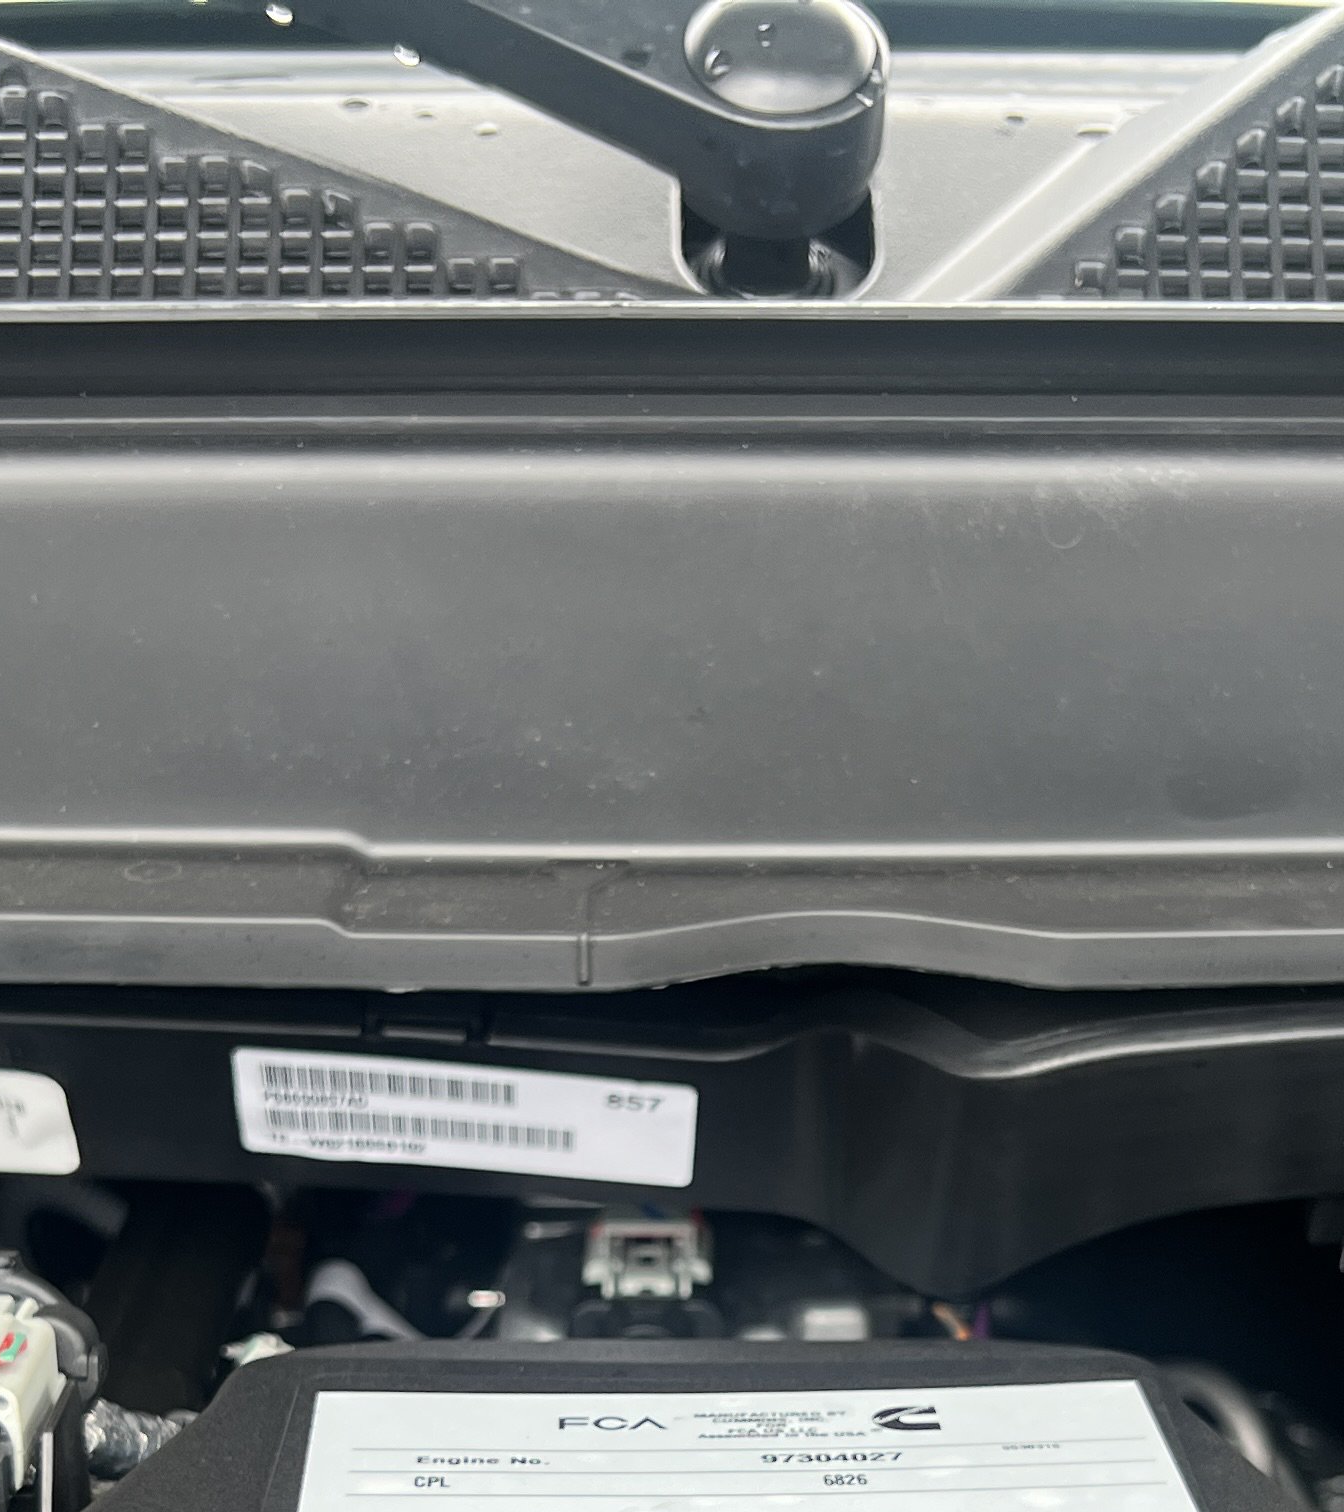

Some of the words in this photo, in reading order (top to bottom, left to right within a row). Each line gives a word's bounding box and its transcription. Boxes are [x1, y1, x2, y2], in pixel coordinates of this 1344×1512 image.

[558, 1415, 667, 1431] FCA
[417, 1455, 500, 1466] Engine
[510, 1456, 550, 1466] No.
[760, 1451, 903, 1463] 97304027
[413, 1475, 451, 1488] CPL
[823, 1473, 868, 1486] 6826
